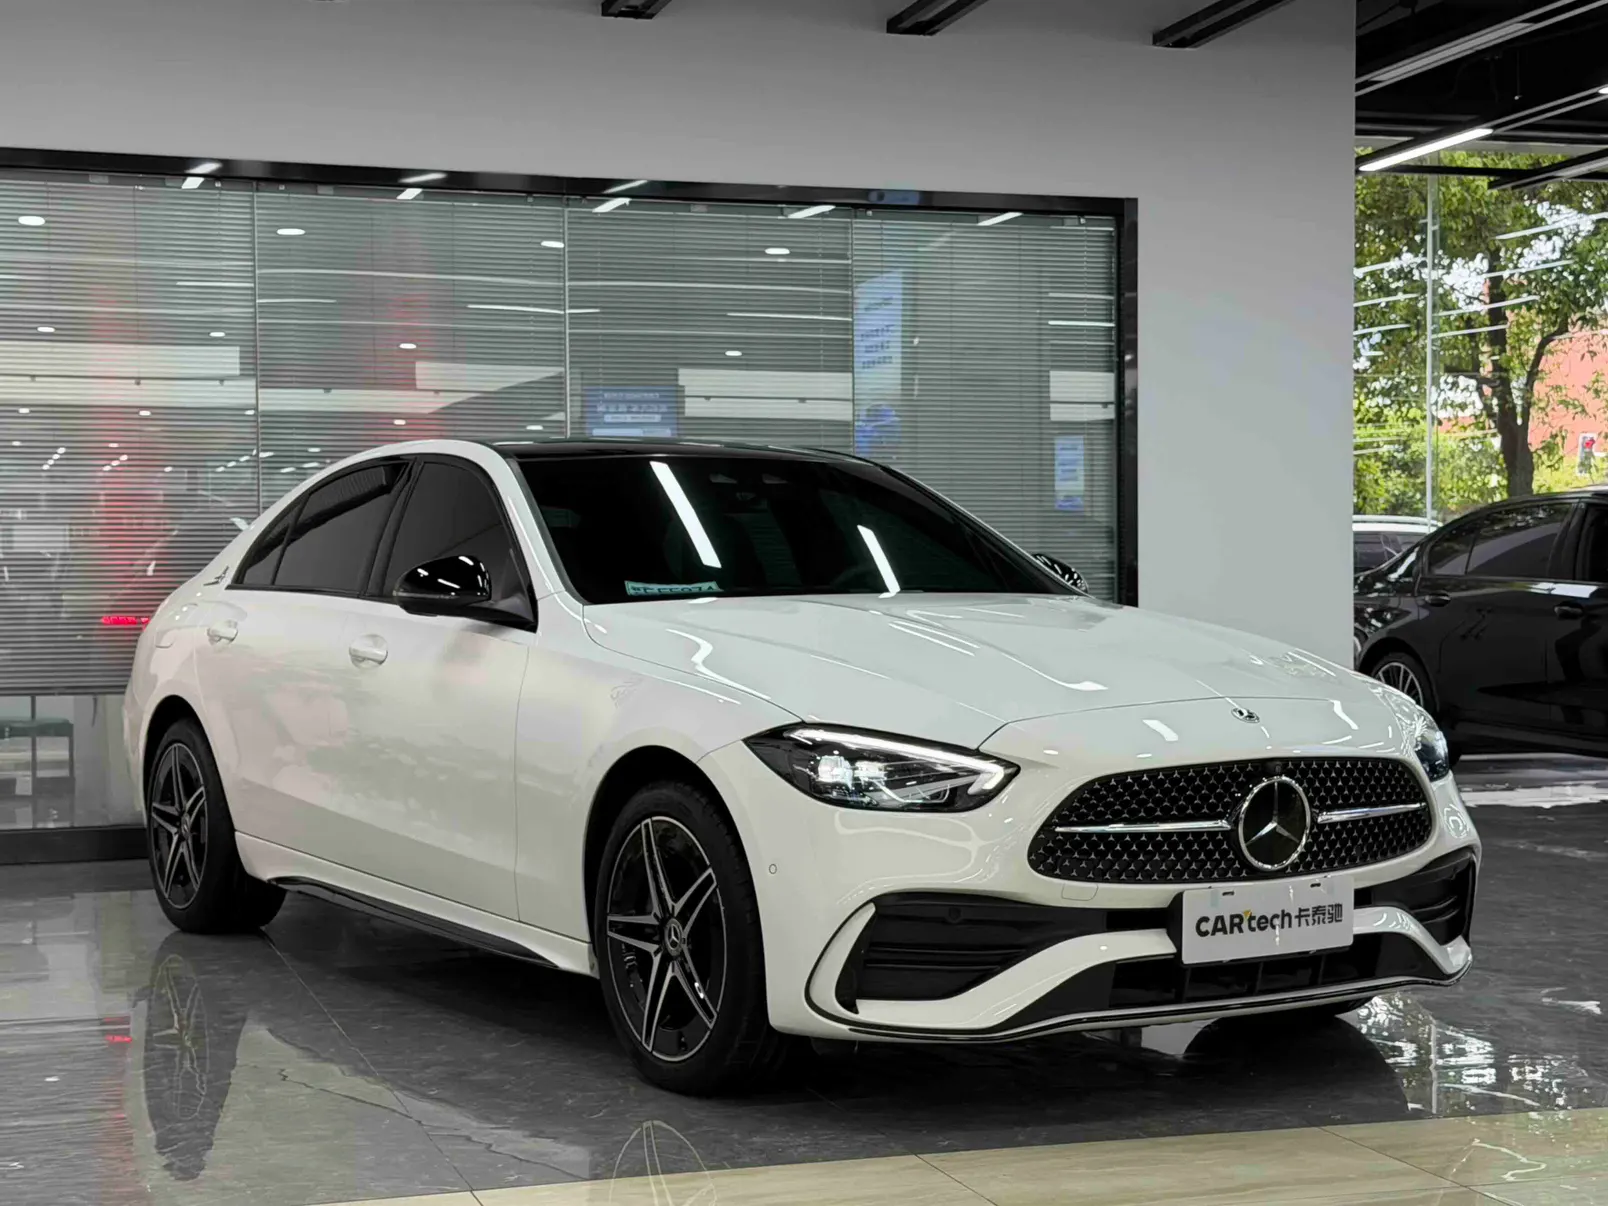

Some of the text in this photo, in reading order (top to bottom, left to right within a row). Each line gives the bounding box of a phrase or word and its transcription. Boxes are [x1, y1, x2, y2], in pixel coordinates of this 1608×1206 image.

[1195, 903, 1343, 937] CARtech 卡泰驰
